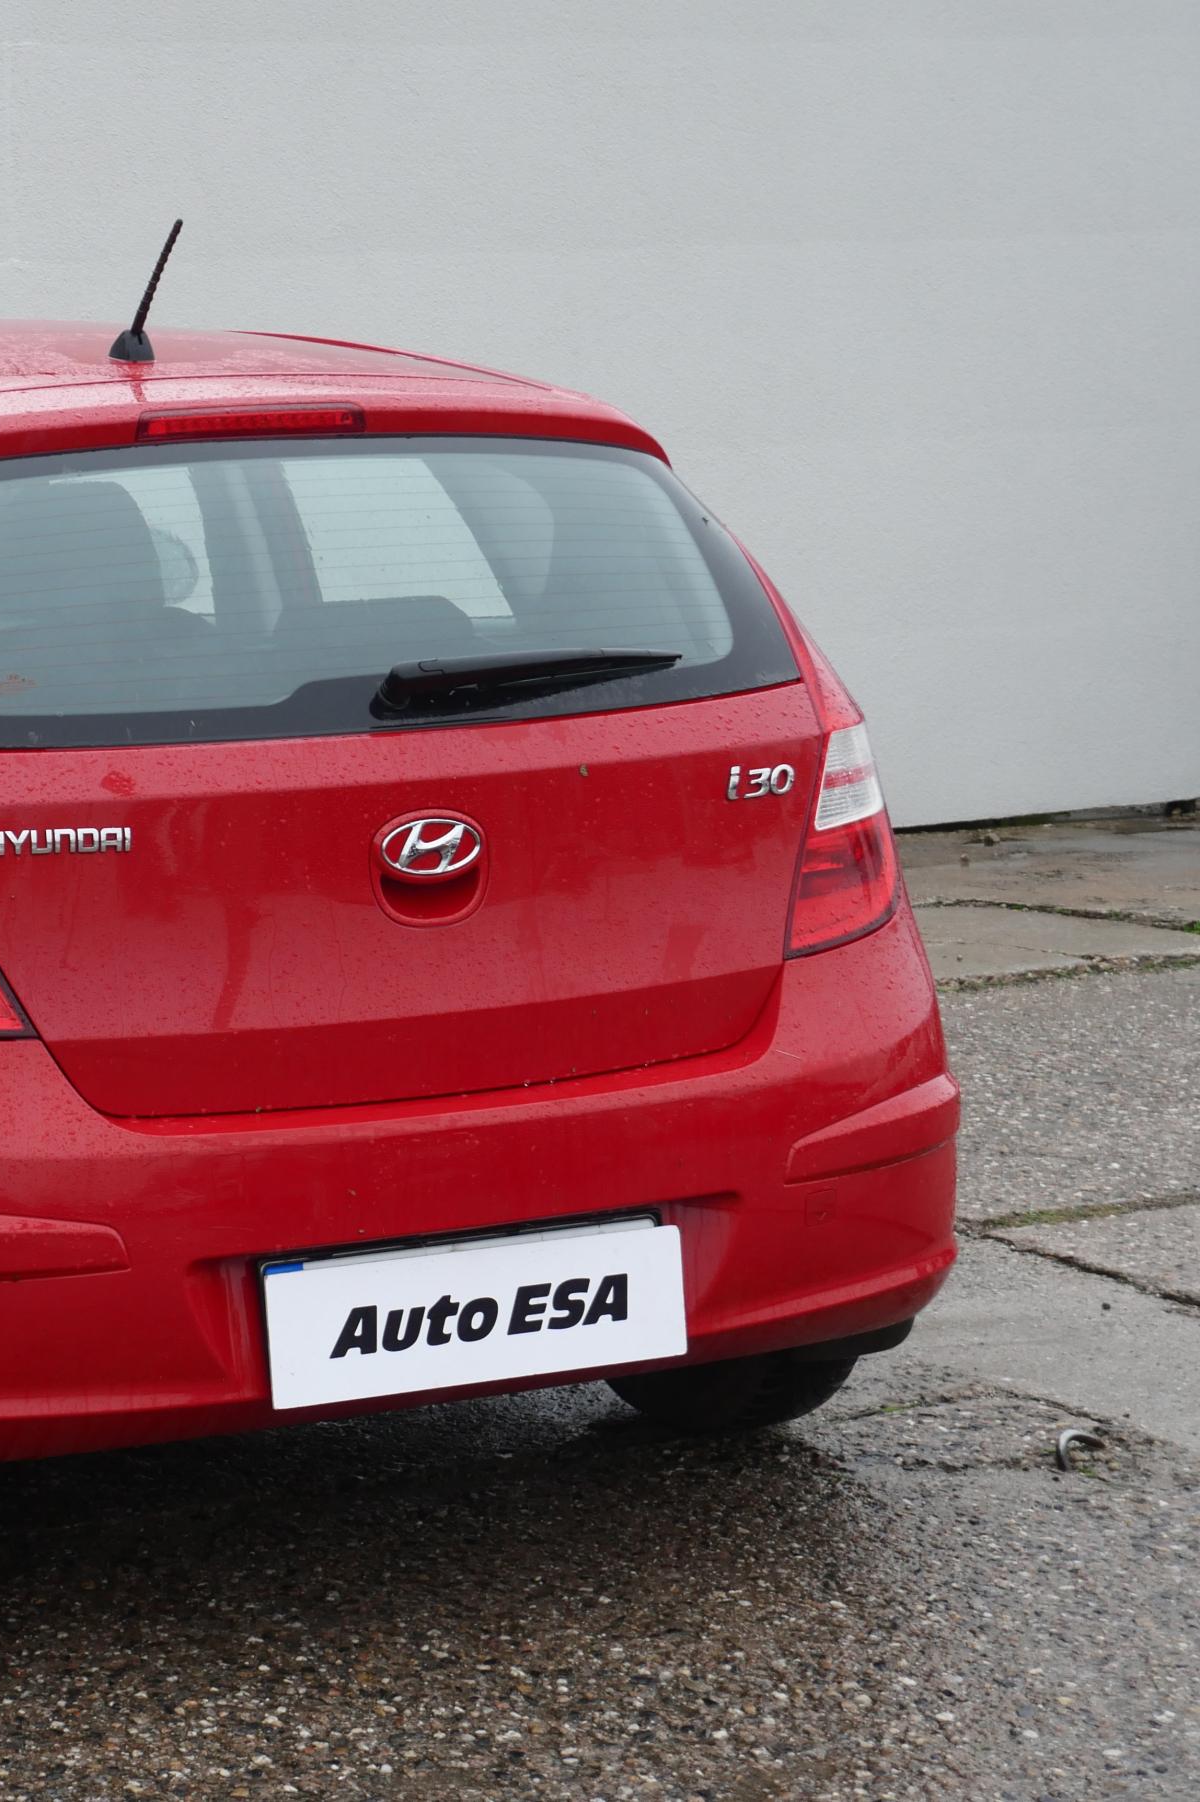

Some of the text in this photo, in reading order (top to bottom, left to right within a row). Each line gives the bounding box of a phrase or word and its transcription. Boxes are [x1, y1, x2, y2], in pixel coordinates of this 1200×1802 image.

[726, 763, 795, 801] i30
[329, 1272, 628, 1359] Auto ESA
